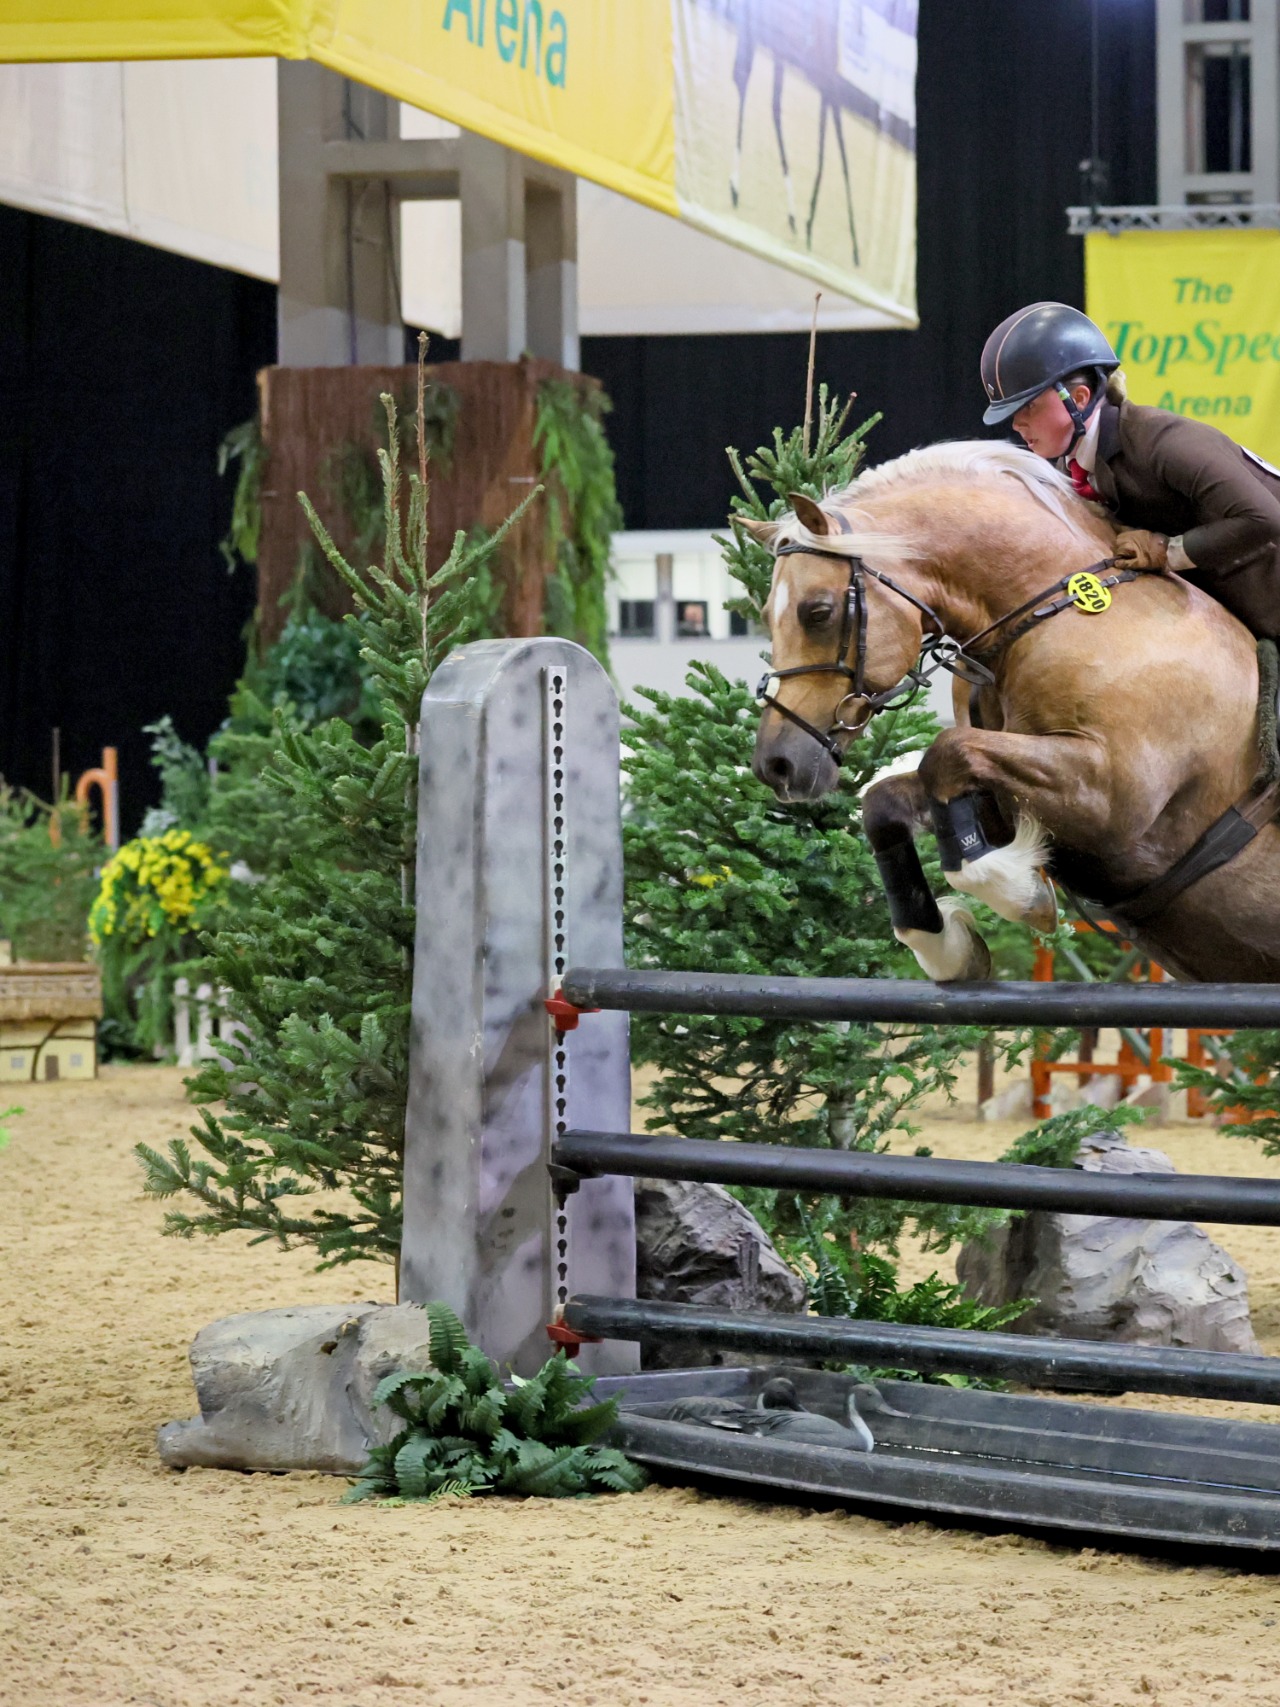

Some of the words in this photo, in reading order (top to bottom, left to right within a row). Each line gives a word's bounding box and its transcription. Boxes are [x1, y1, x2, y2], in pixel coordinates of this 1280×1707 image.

[1174, 277, 1234, 304] The
[1156, 391, 1253, 416] Arena
[1074, 574, 1106, 610] 1820
